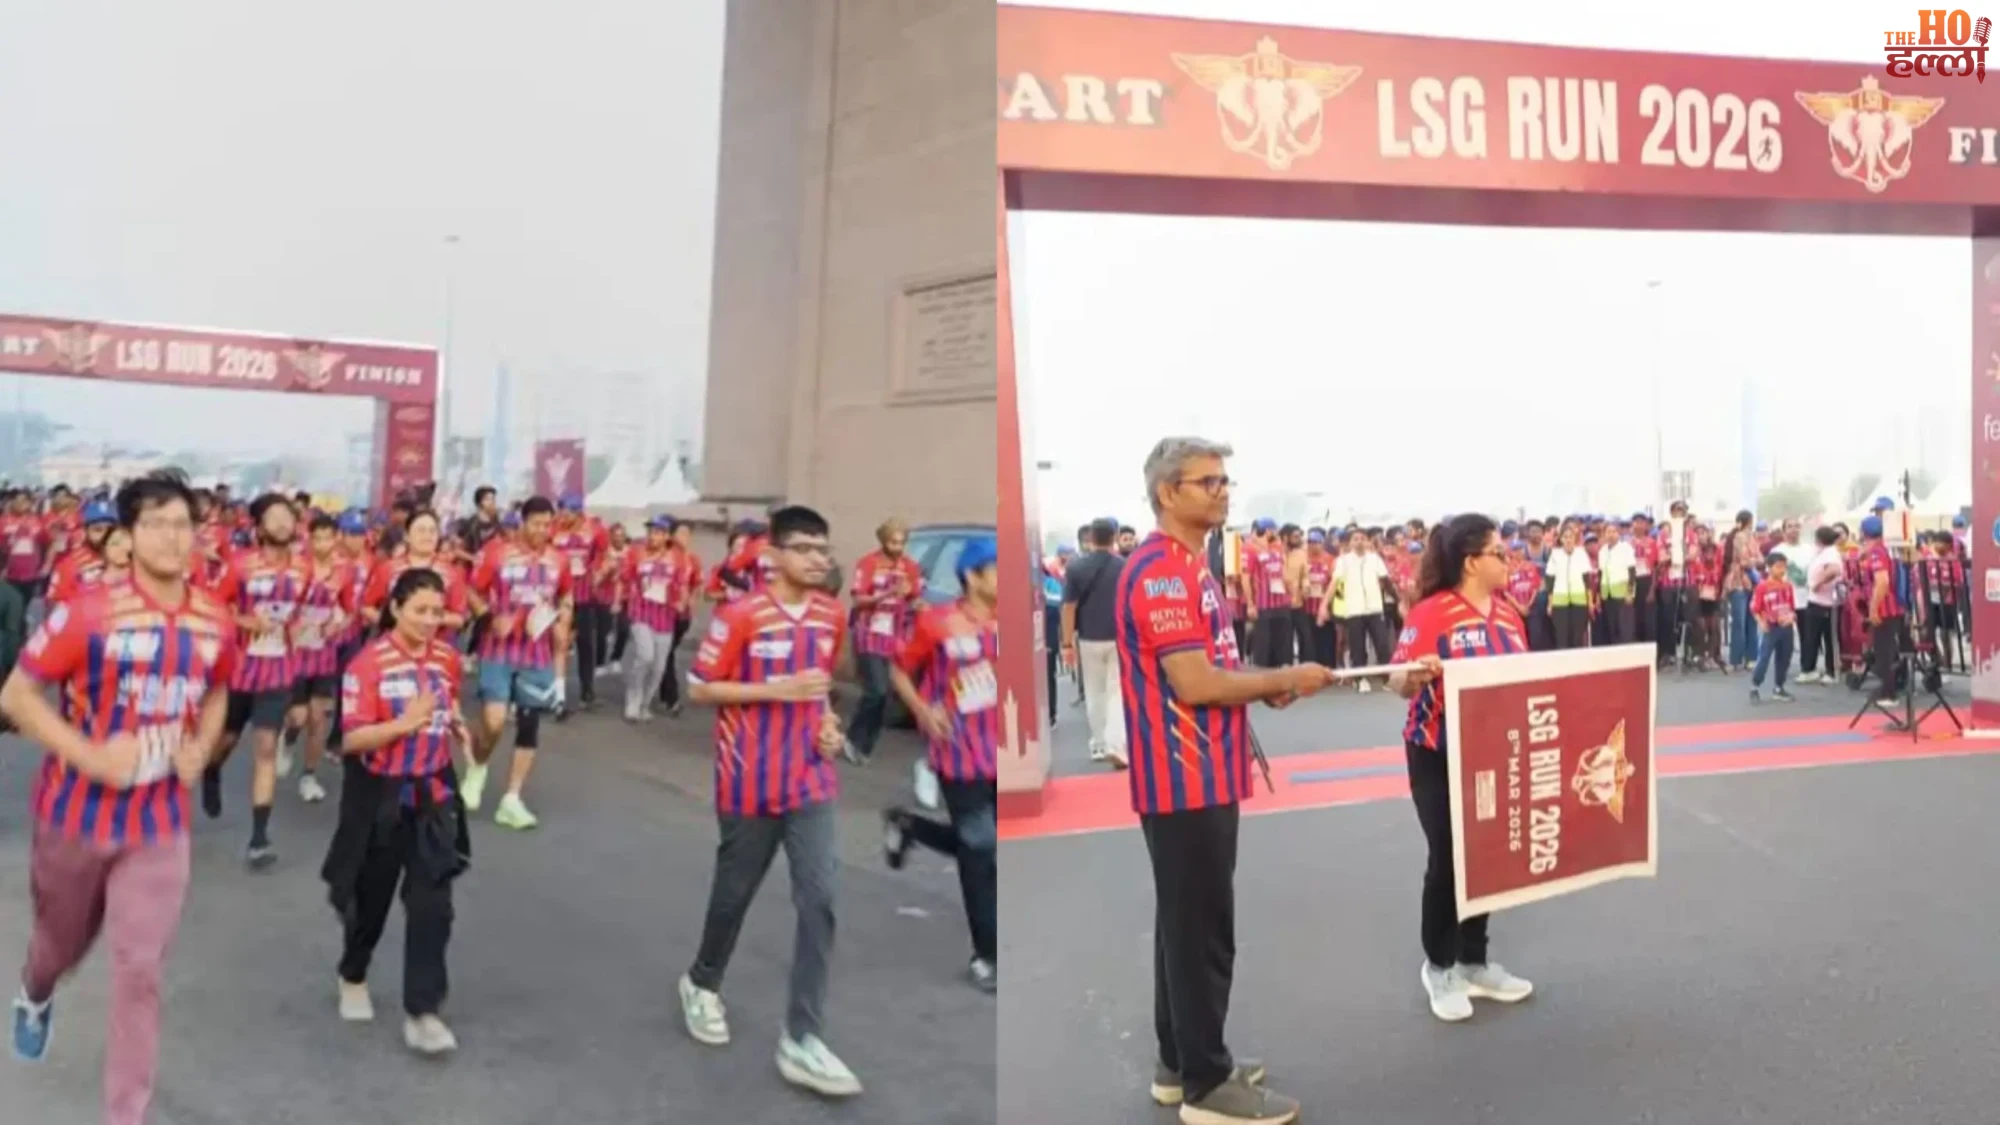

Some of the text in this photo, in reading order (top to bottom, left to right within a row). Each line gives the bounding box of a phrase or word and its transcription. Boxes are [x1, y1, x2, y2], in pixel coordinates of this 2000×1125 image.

[1376, 77, 1488, 160] LSG
[1507, 75, 1620, 164] RUN
[1639, 84, 1783, 173] 2026
[116, 339, 160, 371] LSG
[166, 341, 213, 375] RUN
[217, 344, 278, 381] 2026
[344, 364, 423, 385] FINISH
[1508, 757, 1521, 800] MAR
[1527, 694, 1562, 876] LSG RUN 2026
[1508, 806, 1522, 852] 2026
